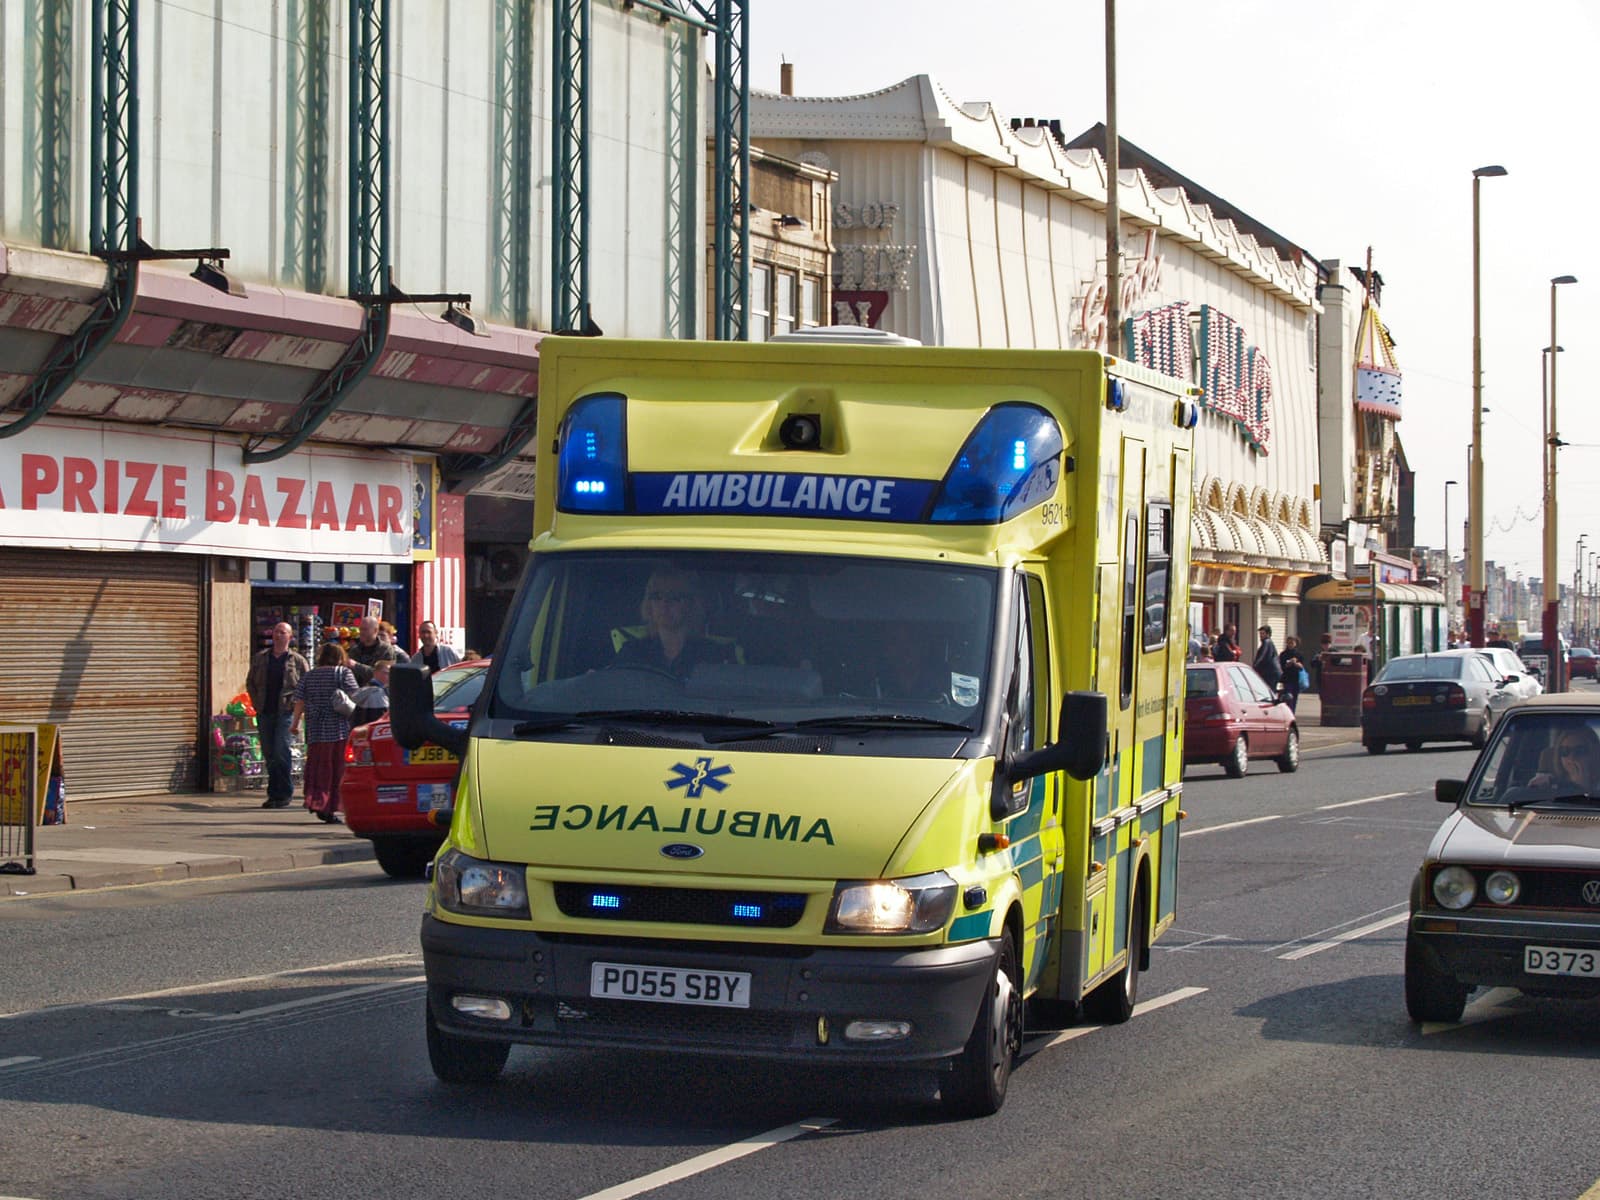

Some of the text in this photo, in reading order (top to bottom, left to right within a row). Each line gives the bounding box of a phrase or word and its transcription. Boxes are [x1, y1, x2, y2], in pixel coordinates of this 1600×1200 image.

[22, 453, 187, 520] PRIZE
[205, 468, 403, 534] BAZAAR
[662, 473, 896, 514] AMBULANCE
[1528, 949, 1595, 973] D373
[685, 974, 741, 1002] SBY
